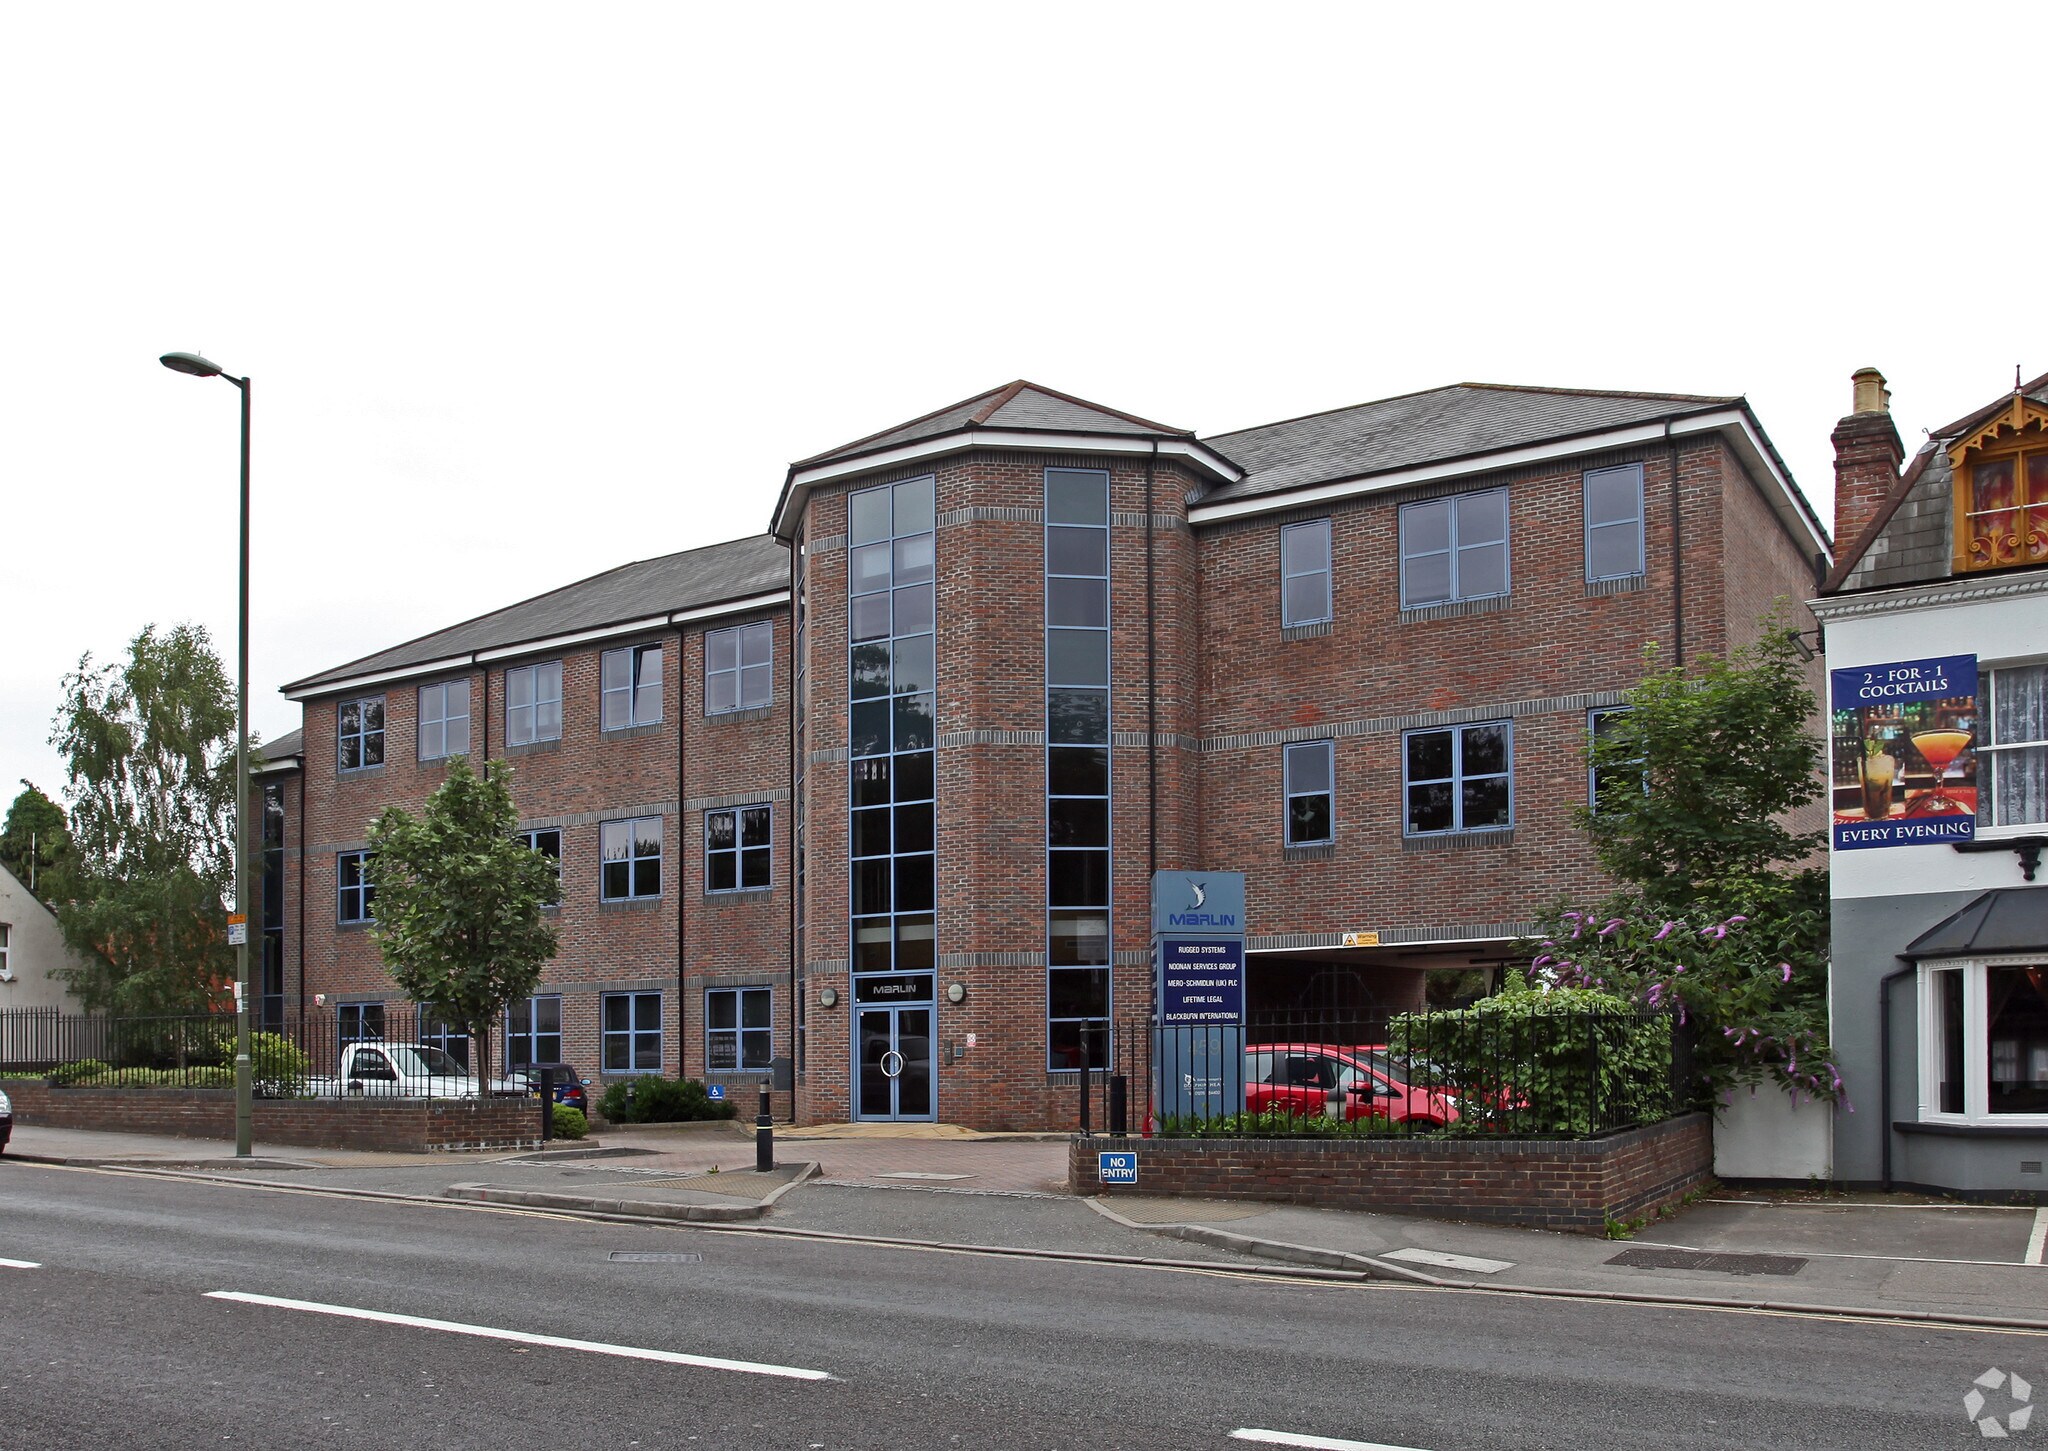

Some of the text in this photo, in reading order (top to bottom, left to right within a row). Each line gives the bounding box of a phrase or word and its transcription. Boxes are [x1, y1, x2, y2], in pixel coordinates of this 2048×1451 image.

[1863, 673, 1873, 684] 2
[1888, 667, 1921, 682] FOR
[1936, 665, 1942, 677] 1
[1859, 678, 1948, 699] COCKTAILS
[1842, 821, 1971, 842] EVERY EVENING
[1178, 946, 1226, 954] RUGGED SYSTEMS
[1215, 979, 1227, 987] (UK)
[1227, 979, 1238, 987] PLC
[1182, 995, 1223, 1003] LIFETIME LEGAL
[1165, 1012, 1198, 1020] BLACKBURN
[1110, 1157, 1126, 1168] NO
[1102, 1168, 1134, 1178] ENTRY
